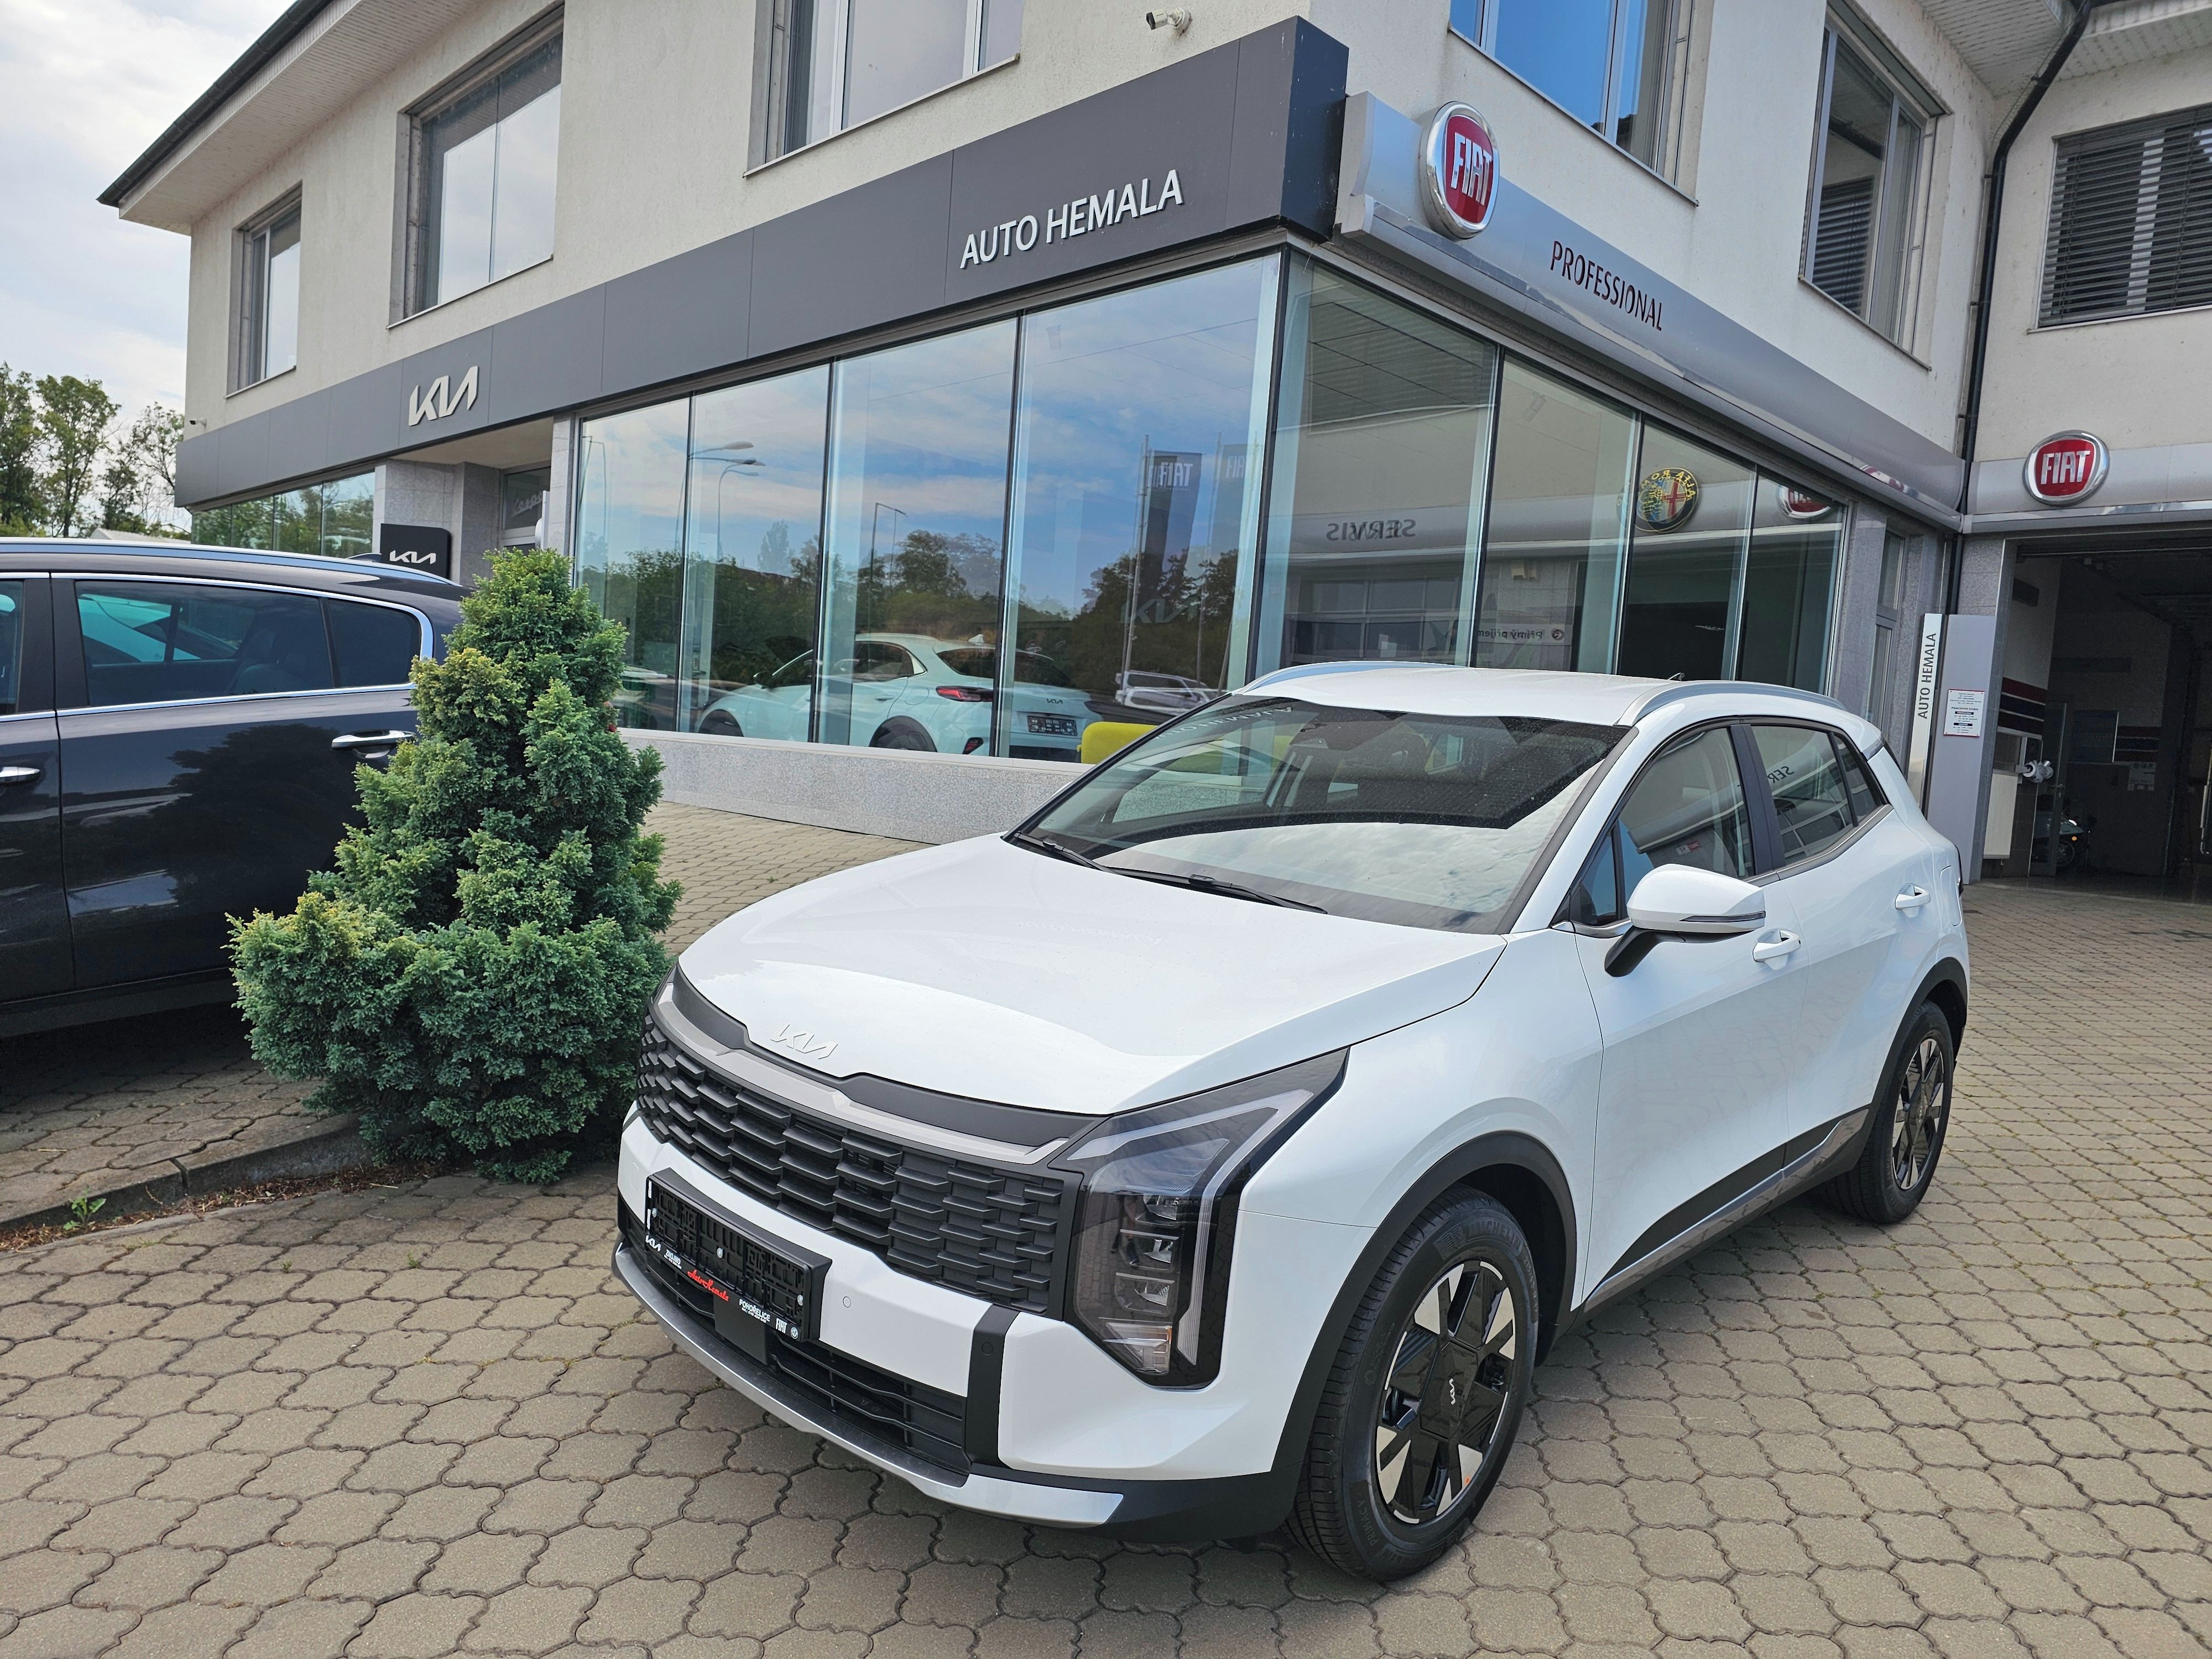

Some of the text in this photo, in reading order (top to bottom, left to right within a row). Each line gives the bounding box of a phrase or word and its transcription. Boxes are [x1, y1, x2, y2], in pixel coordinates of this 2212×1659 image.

[1451, 131, 1494, 207] FIAT
[959, 169, 1184, 269] AUTO HEMALA
[1550, 240, 1663, 332] PROFESSIONAL
[408, 365, 479, 427] KIA
[1160, 462, 1194, 487] FIAT
[2040, 449, 2091, 485] FIAT
[389, 550, 437, 565] KIA
[1917, 632, 1938, 720] AUTO HEMALA
[770, 1024, 839, 1060] KIA
[645, 1235, 661, 1252] KIA
[775, 1317, 787, 1334] FIAT
[1357, 1500, 1380, 1546] PRIMACY
